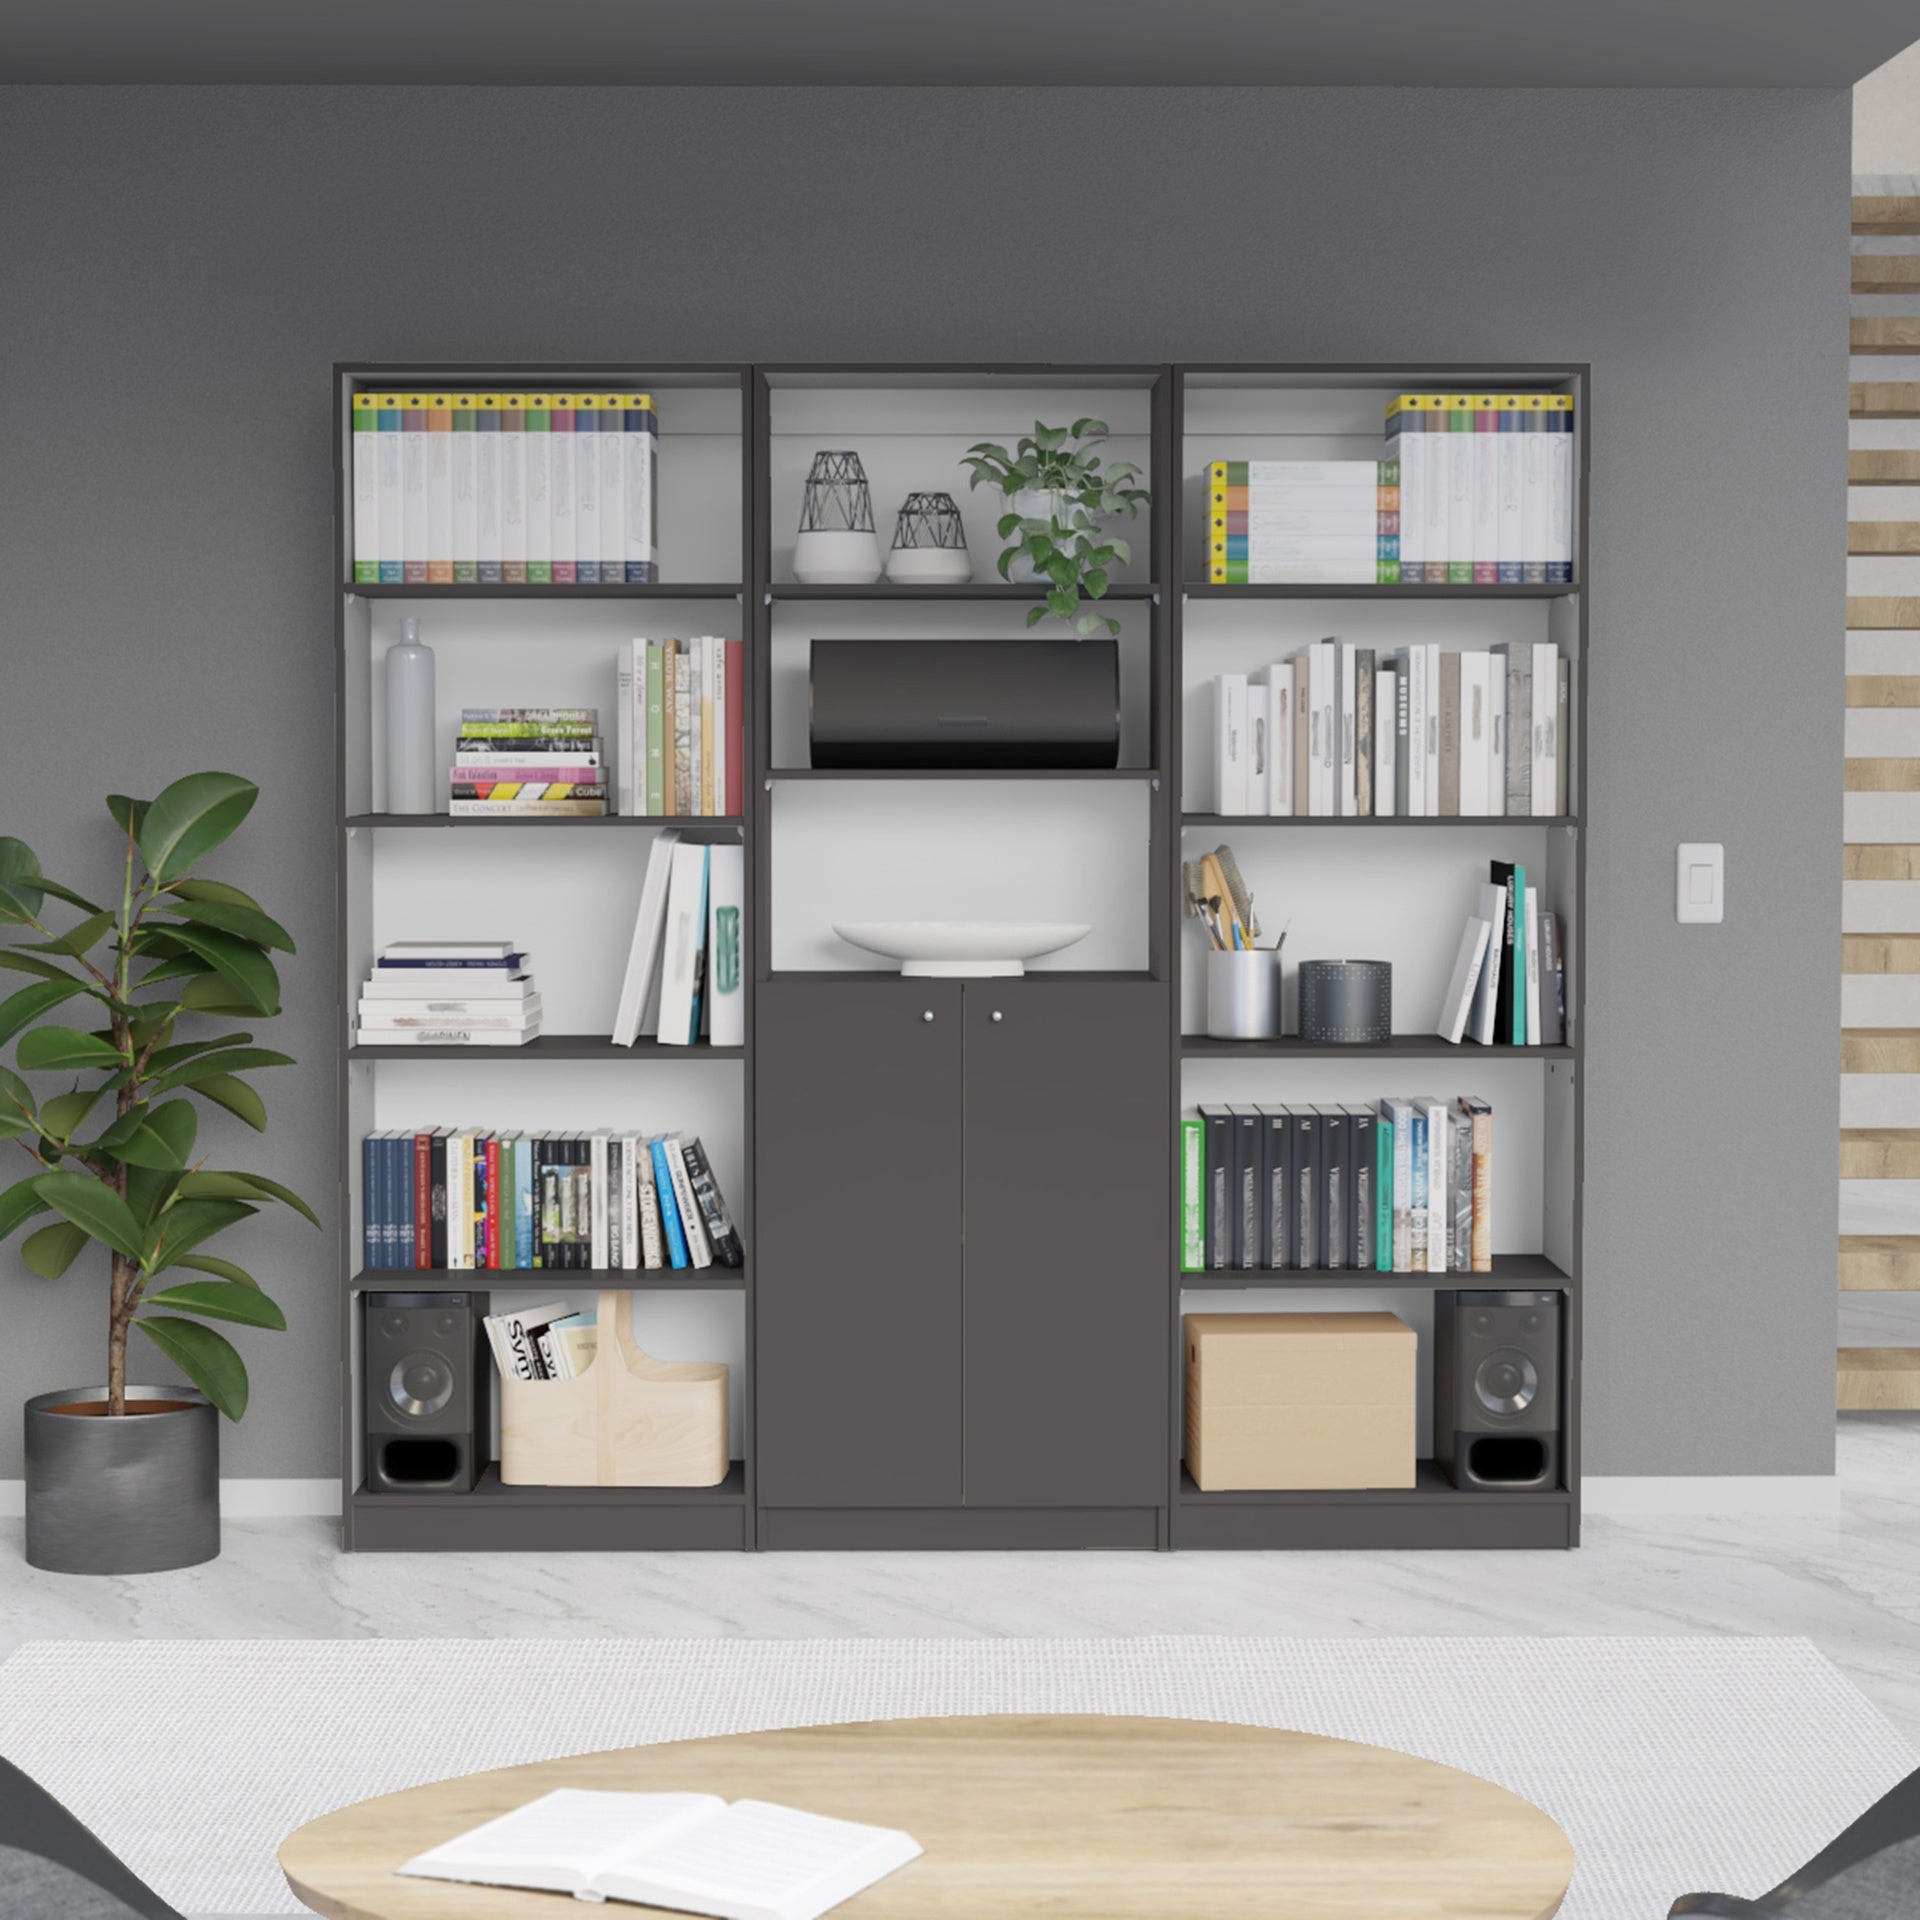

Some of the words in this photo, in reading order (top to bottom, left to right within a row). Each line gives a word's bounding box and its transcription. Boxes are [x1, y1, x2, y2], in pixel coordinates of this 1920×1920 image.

[665, 688, 673, 715] WAY
[1399, 676, 1407, 736] MUSEUMS
[575, 787, 603, 796] Cube
[640, 1184, 659, 1266] STONEWORKS
